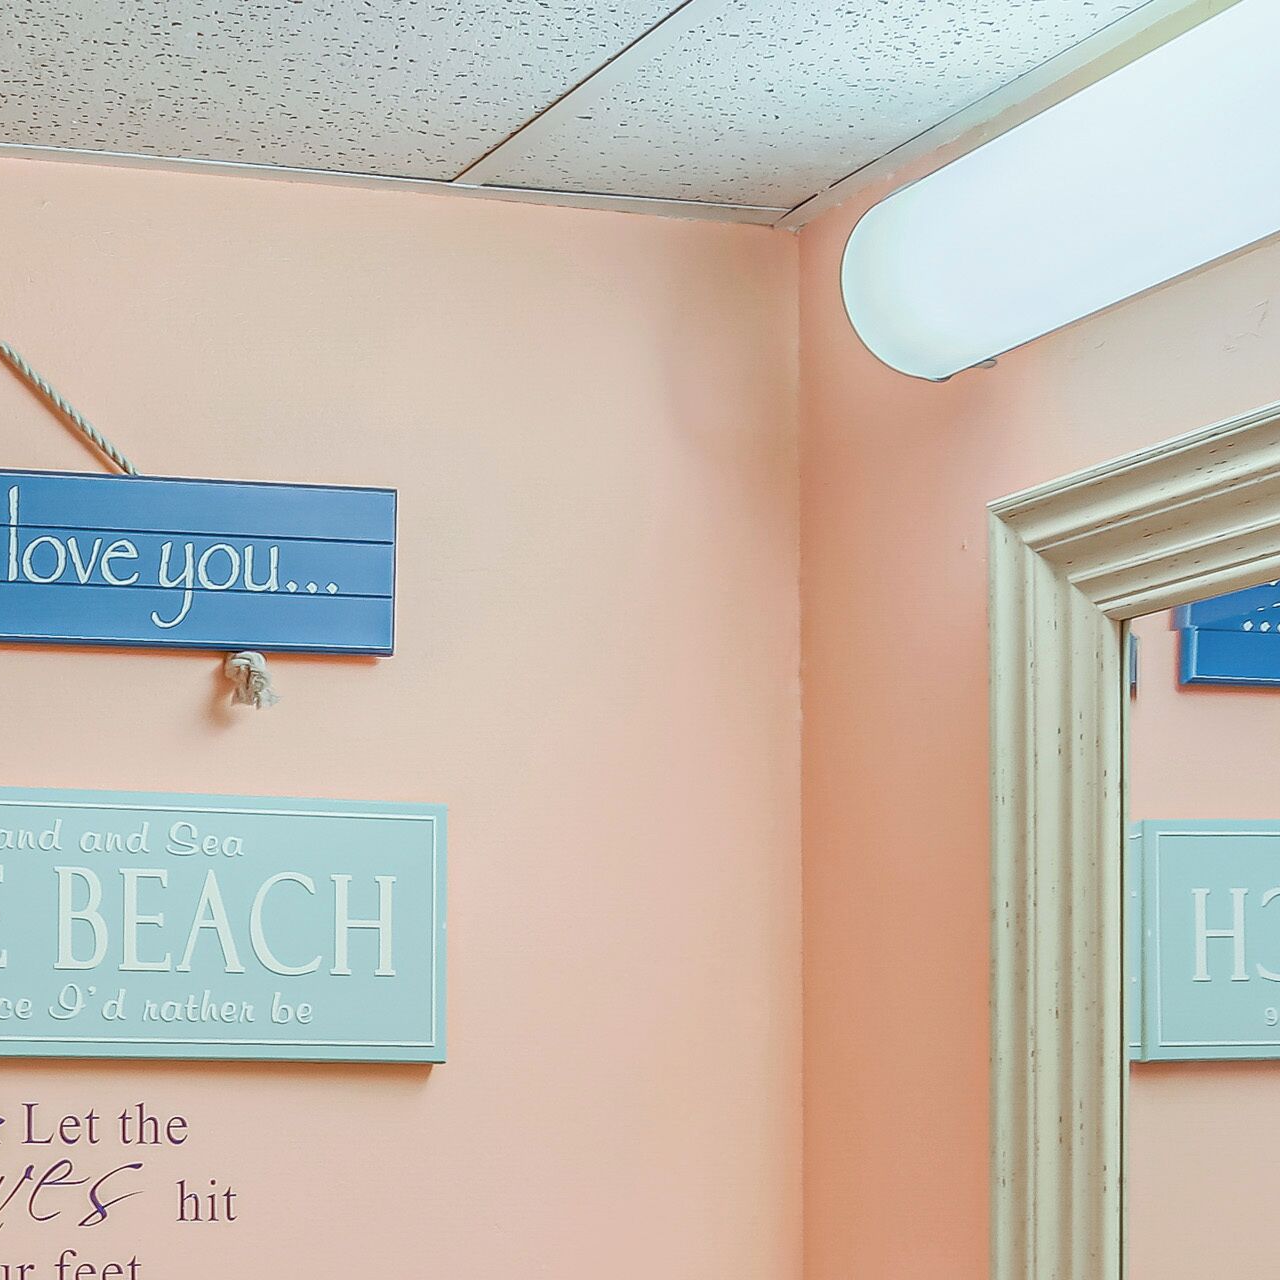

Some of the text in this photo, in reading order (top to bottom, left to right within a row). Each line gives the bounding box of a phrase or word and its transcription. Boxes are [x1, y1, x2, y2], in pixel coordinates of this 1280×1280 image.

[8, 485, 141, 587] love
[79, 821, 150, 854] and
[166, 821, 245, 857] Sea
[53, 865, 397, 977] BEACH
[143, 990, 255, 1023] rather
[271, 991, 314, 1025] be
[21, 1102, 188, 1145] Let the
[175, 1179, 238, 1222] hit
